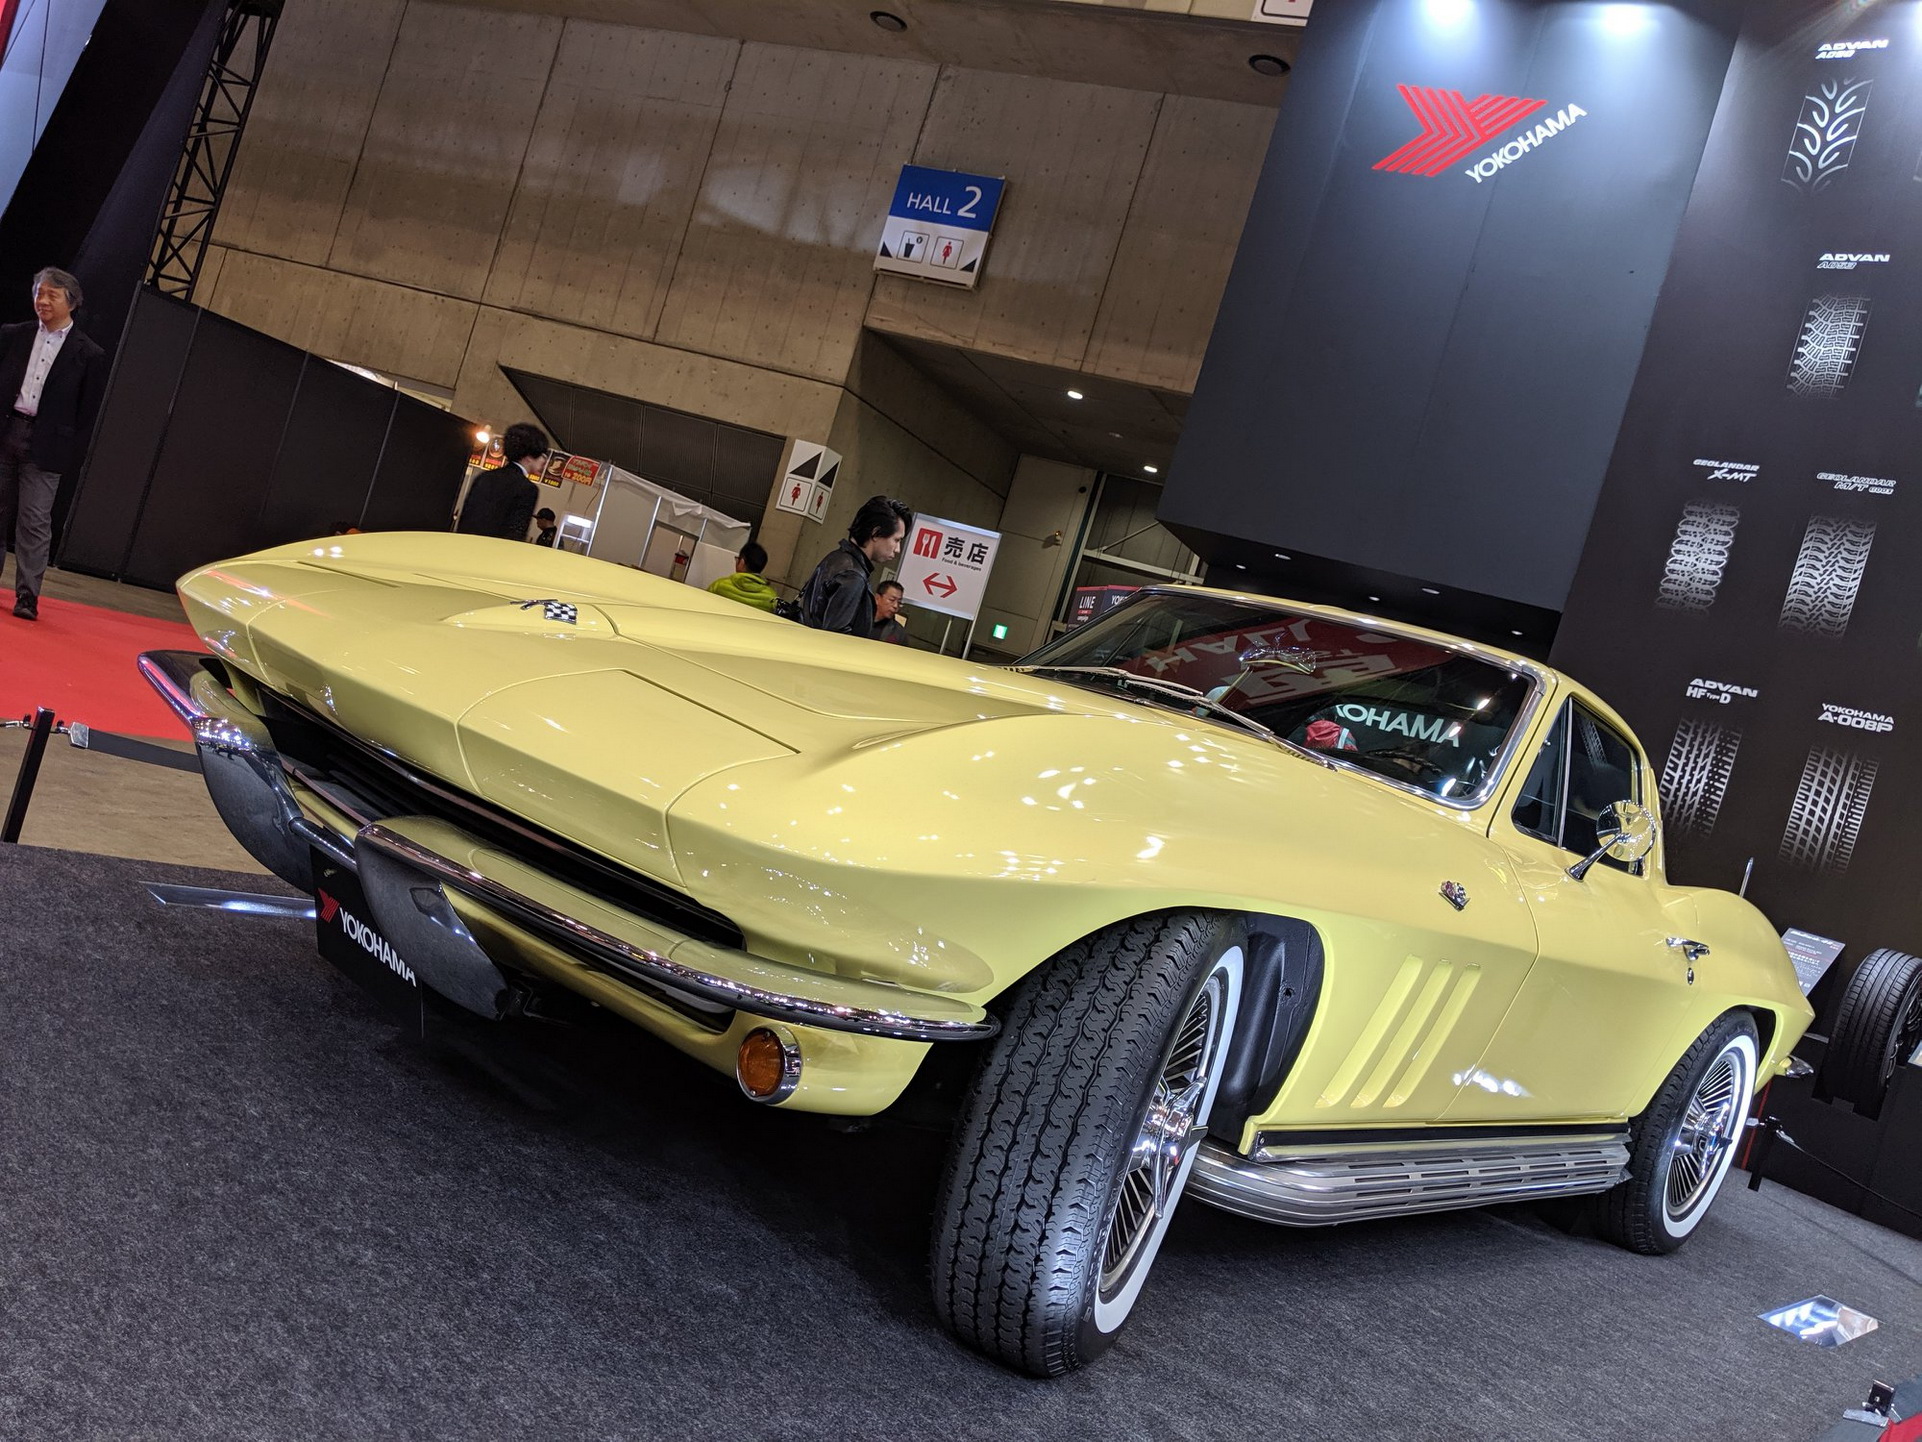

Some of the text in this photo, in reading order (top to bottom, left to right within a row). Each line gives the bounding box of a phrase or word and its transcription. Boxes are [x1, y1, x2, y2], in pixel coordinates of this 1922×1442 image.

[1818, 39, 1889, 51] ADVAN
[1464, 103, 1588, 183] YOKOHAMA
[906, 186, 982, 219] HALL 2
[1819, 253, 1891, 262] ADVAN
[1692, 458, 1760, 471] GEOLANDAR
[1706, 468, 1758, 483] X-MT
[1816, 472, 1897, 487] GEOLANDAR
[943, 536, 989, 565] 売店
[942, 557, 954, 565] Food
[1079, 595, 1097, 609] LINE
[1685, 686, 1707, 699] HF
[1719, 692, 1731, 704] D
[1689, 678, 1759, 698] ADVAN
[1821, 702, 1895, 725] YOKOHAMA
[339, 906, 417, 988] YOKOHAMA
